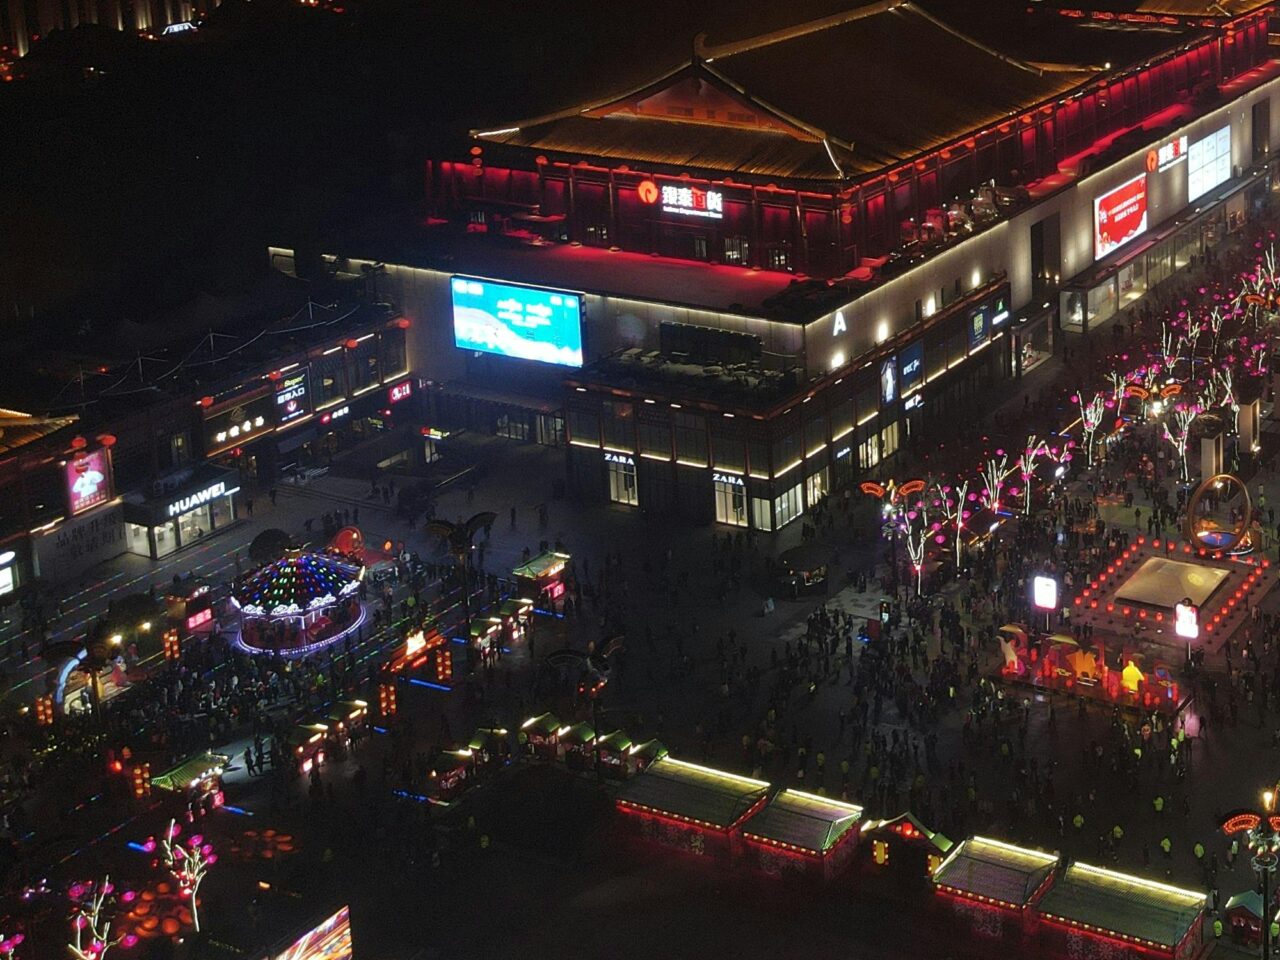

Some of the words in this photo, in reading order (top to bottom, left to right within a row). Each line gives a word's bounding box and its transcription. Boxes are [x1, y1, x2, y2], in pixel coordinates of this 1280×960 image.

[833, 311, 847, 336] A
[605, 453, 635, 466] ZARA
[713, 473, 744, 486] ZARA
[169, 482, 225, 516] HUAWEI
